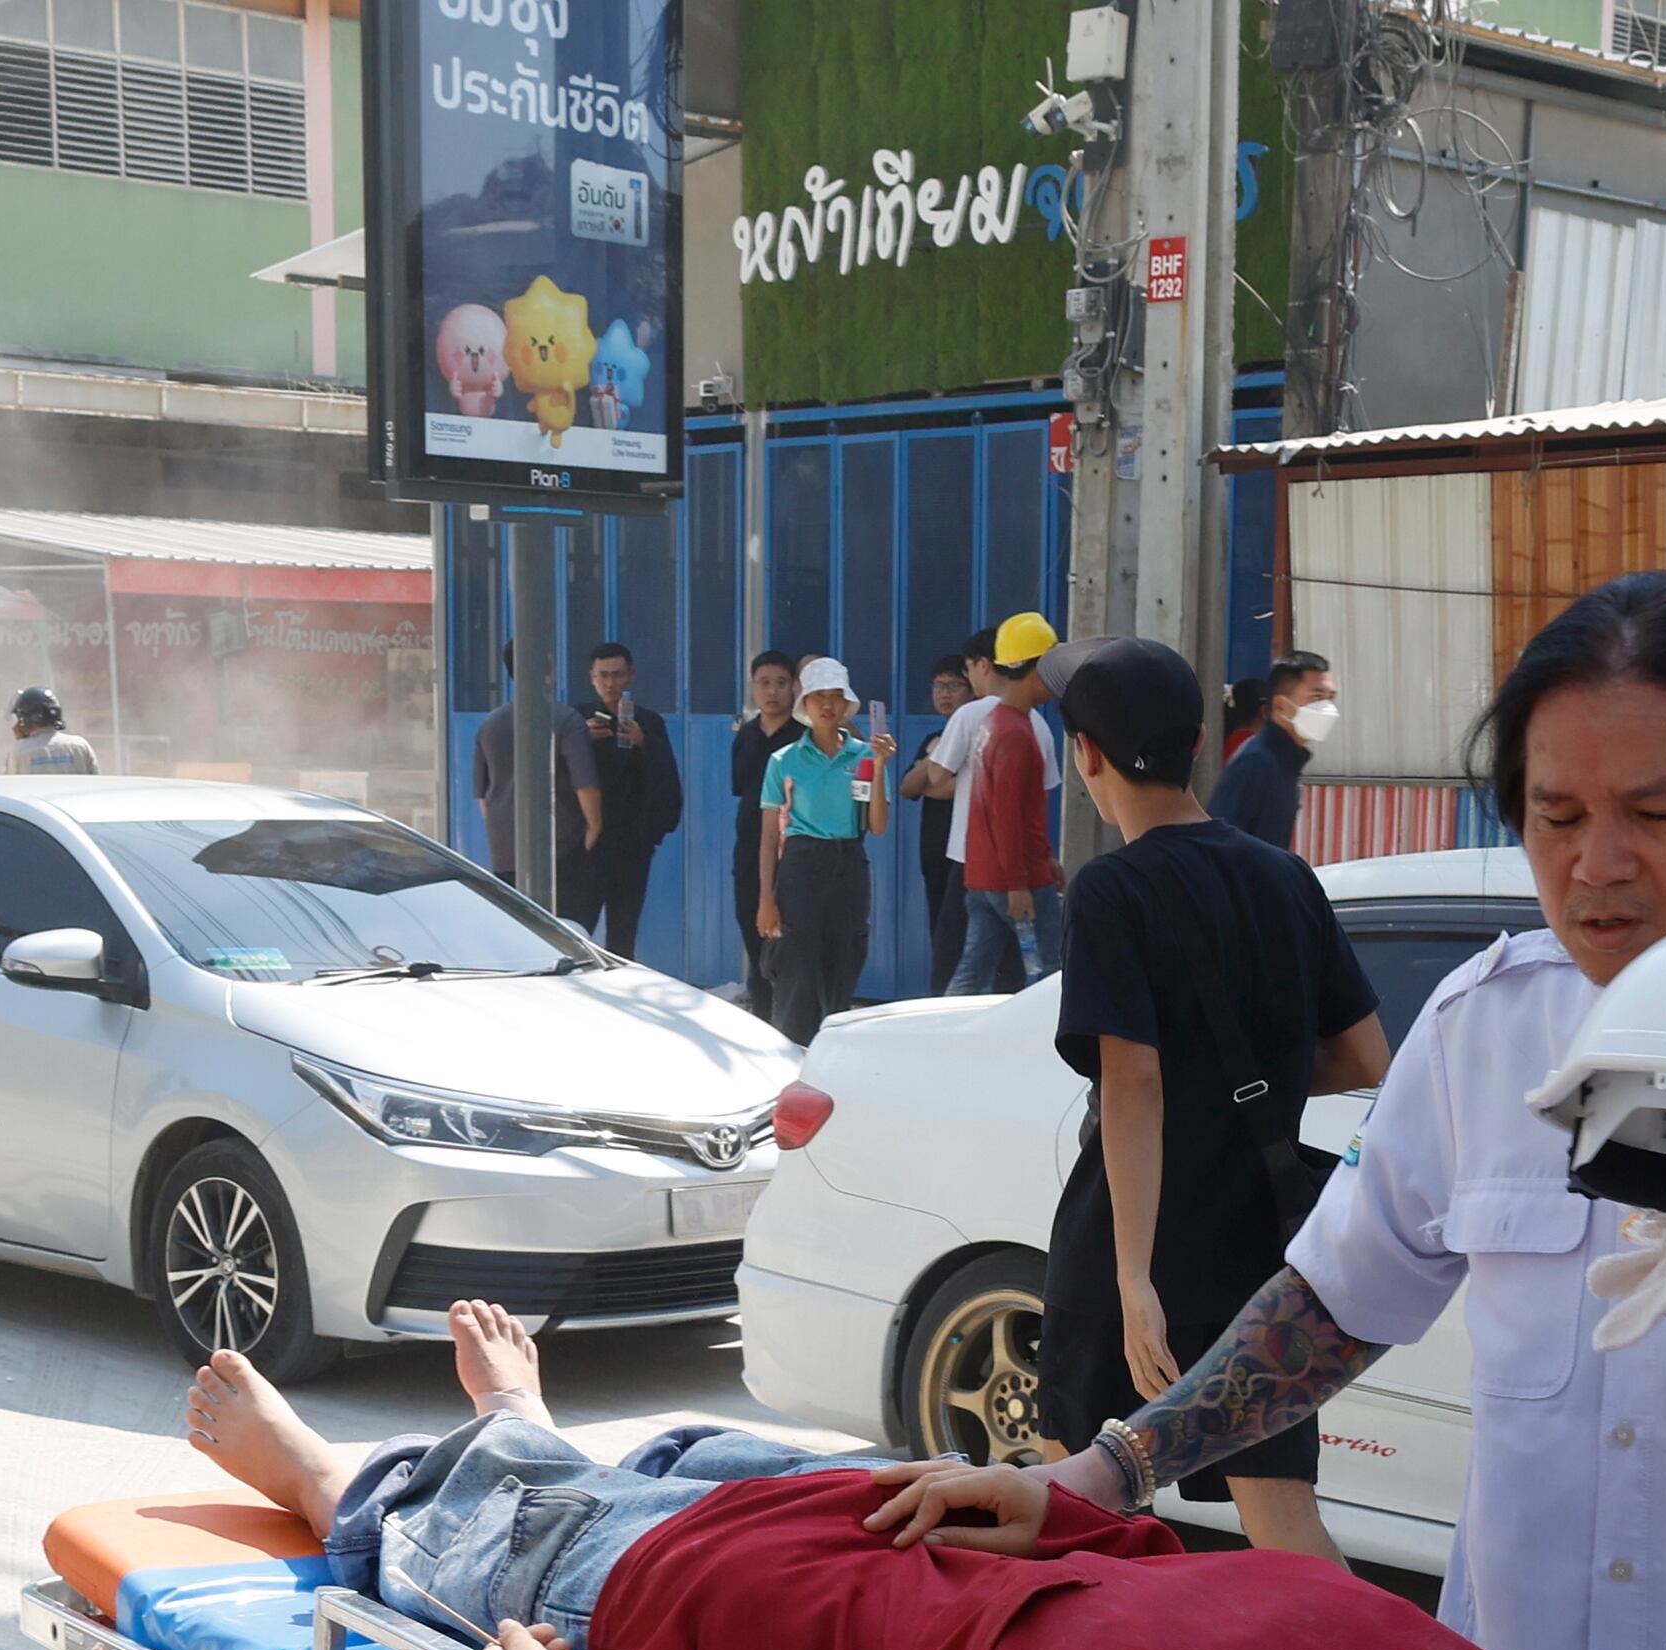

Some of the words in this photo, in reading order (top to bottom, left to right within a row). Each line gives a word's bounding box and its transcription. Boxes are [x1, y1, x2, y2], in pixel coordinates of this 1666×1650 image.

[433, 56, 650, 144] ประกันชีวิต
[578, 180, 626, 210] อันดับ
[733, 148, 1027, 285] หญ้าเทียม
[1151, 254, 1183, 276] BHF
[1150, 277, 1182, 298] 1292
[430, 421, 472, 436] Samsung
